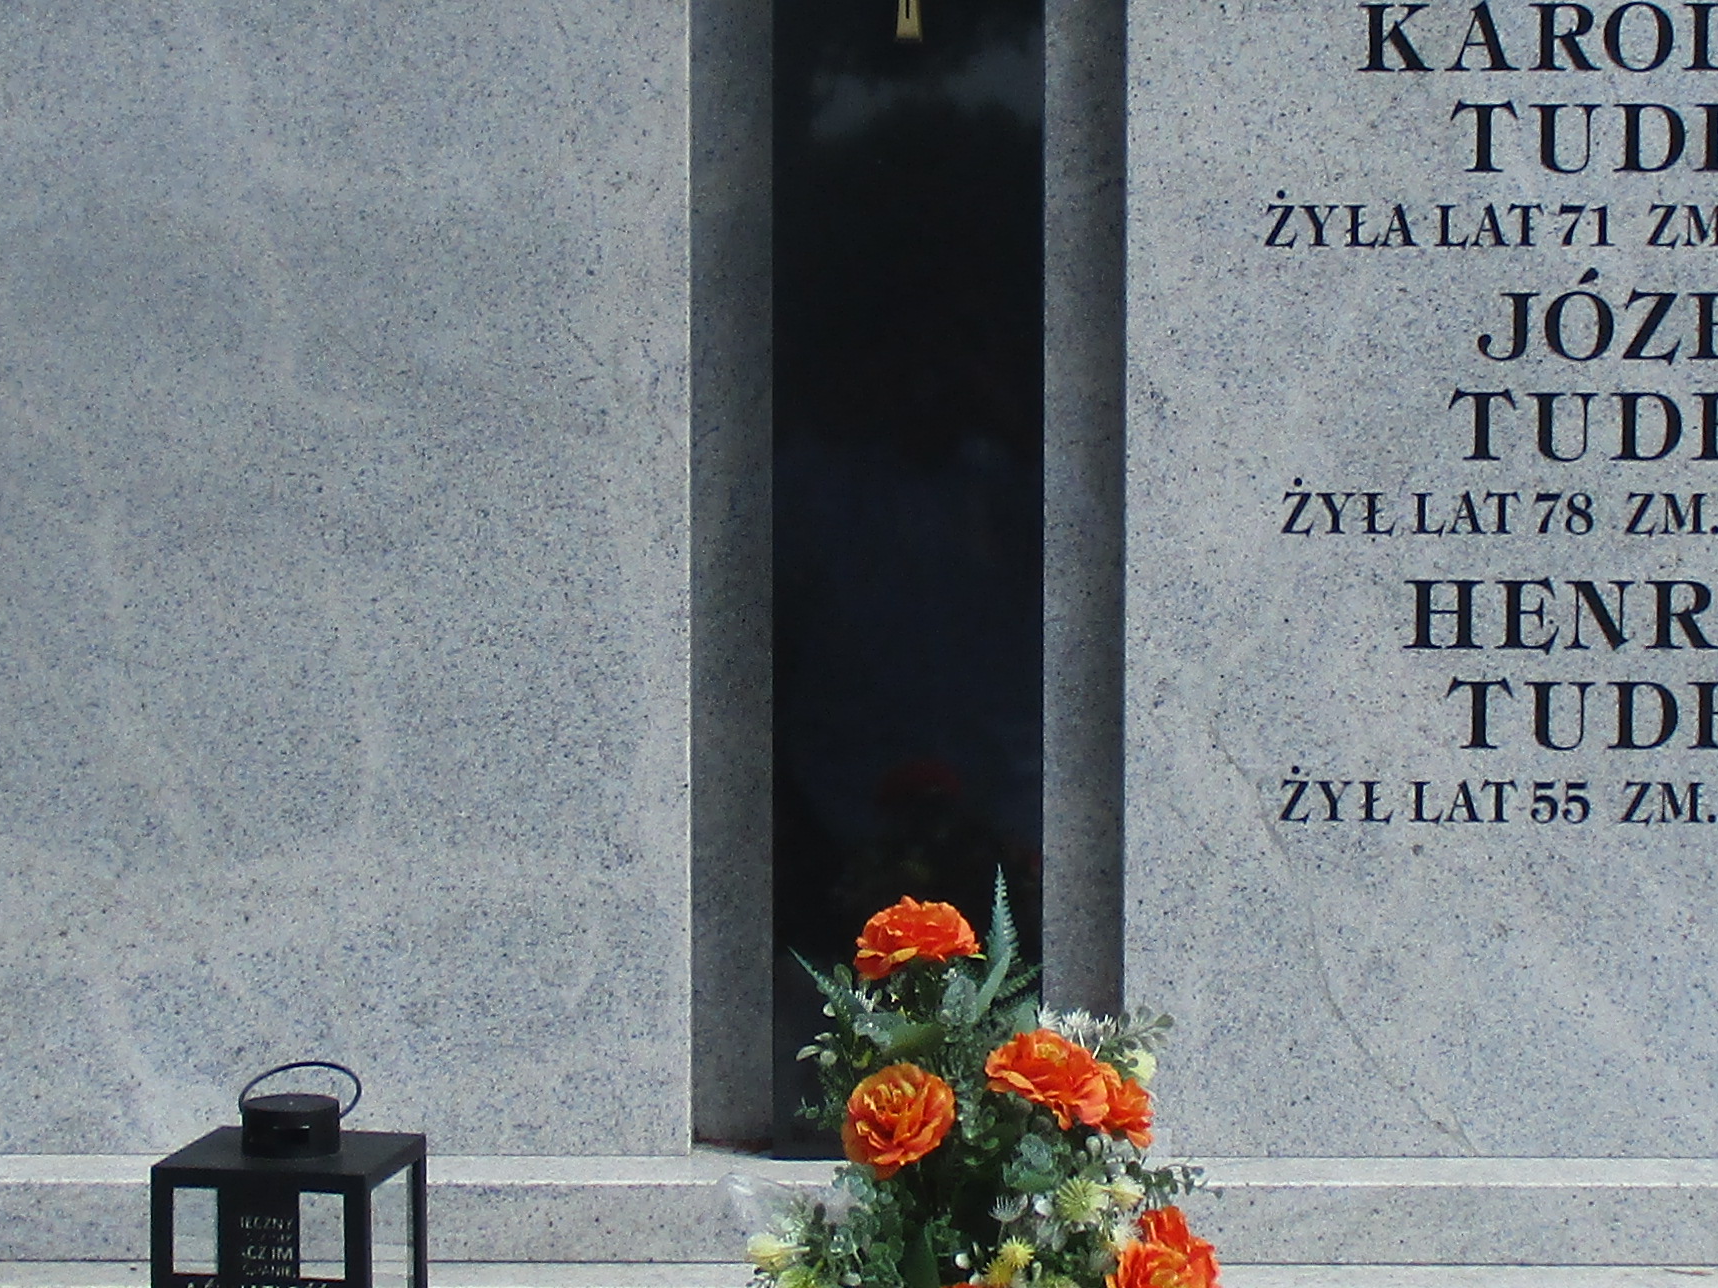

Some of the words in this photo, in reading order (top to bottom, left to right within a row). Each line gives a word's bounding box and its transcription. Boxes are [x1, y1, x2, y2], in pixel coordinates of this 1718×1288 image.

[1265, 189, 1417, 249] ŻYŁA
[1436, 203, 1544, 249] LAT
[1559, 203, 1611, 248] 71
[1281, 477, 1396, 536] ŻYŁ
[1413, 491, 1521, 536] LAT
[1535, 492, 1595, 535] 78
[1280, 766, 1393, 823] ŻYŁ
[1412, 780, 1516, 824] LAT
[1530, 781, 1590, 824] 55
